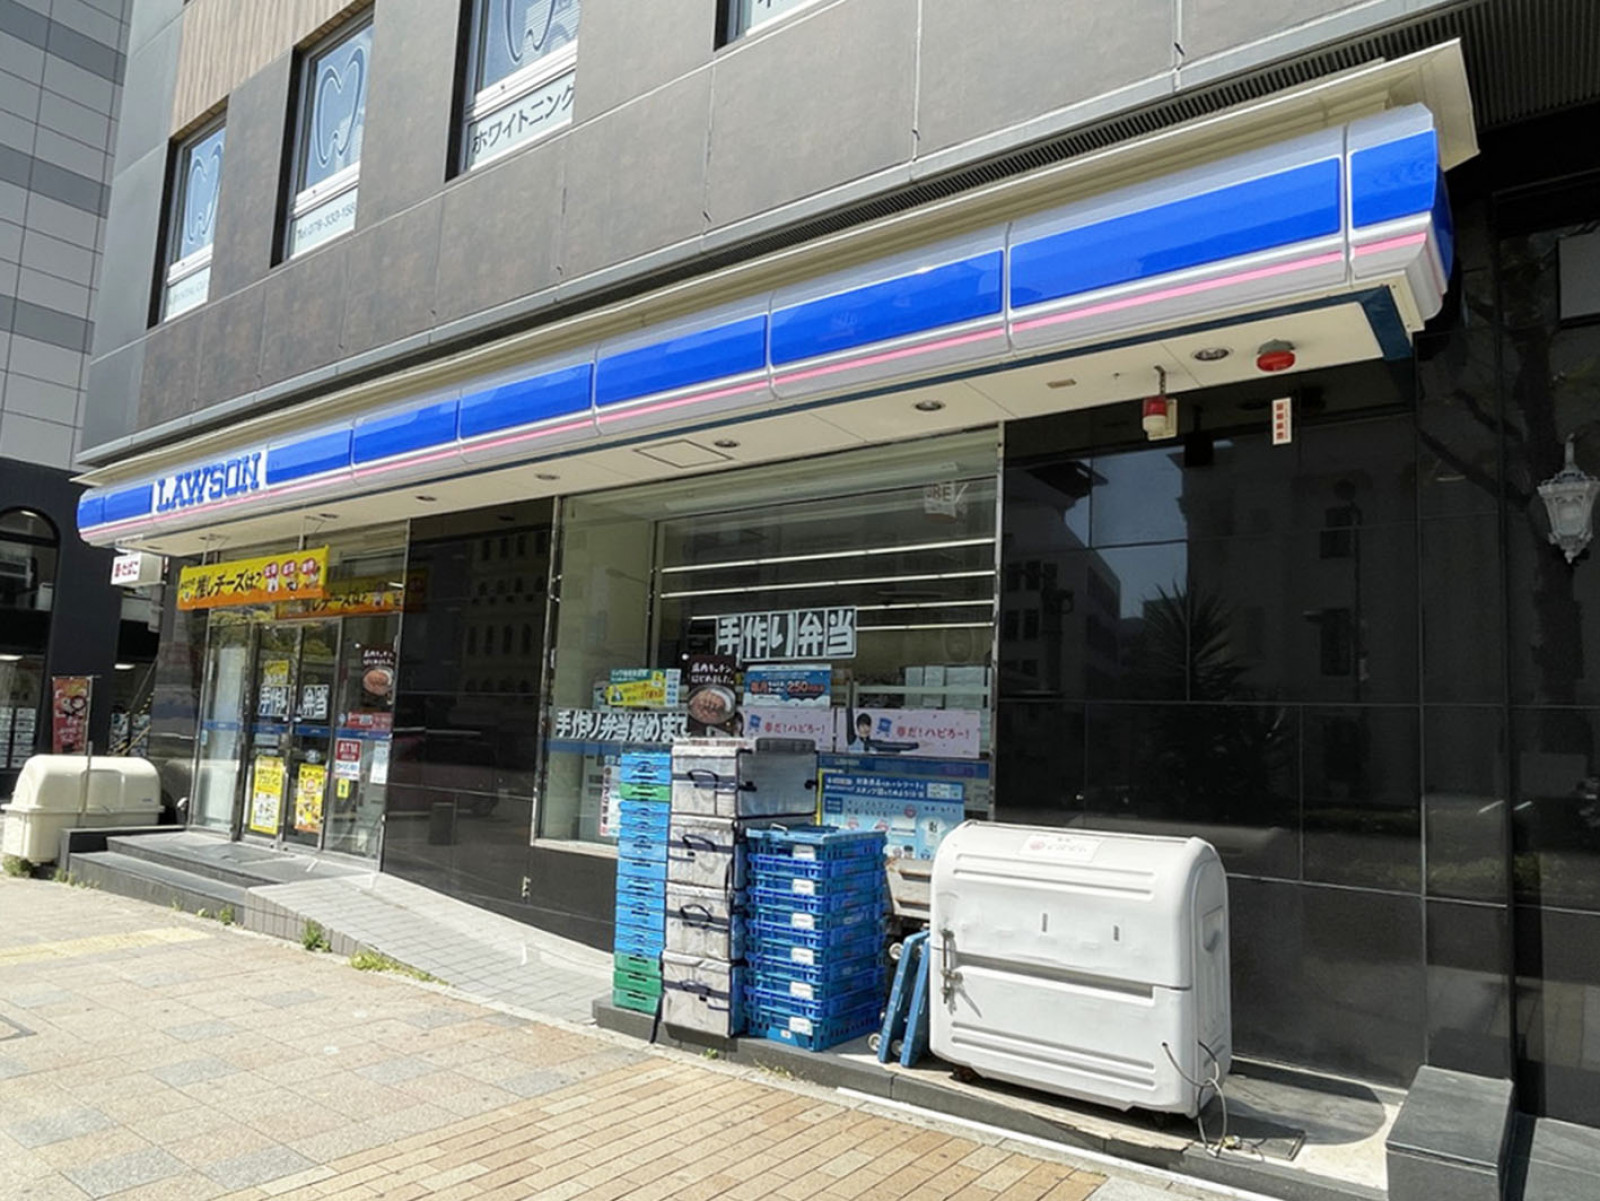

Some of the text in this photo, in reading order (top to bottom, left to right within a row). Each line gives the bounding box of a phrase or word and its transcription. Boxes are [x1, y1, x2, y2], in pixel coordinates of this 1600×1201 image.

[156, 452, 261, 512] LAWSON
[716, 609, 854, 657] 手作り弁当
